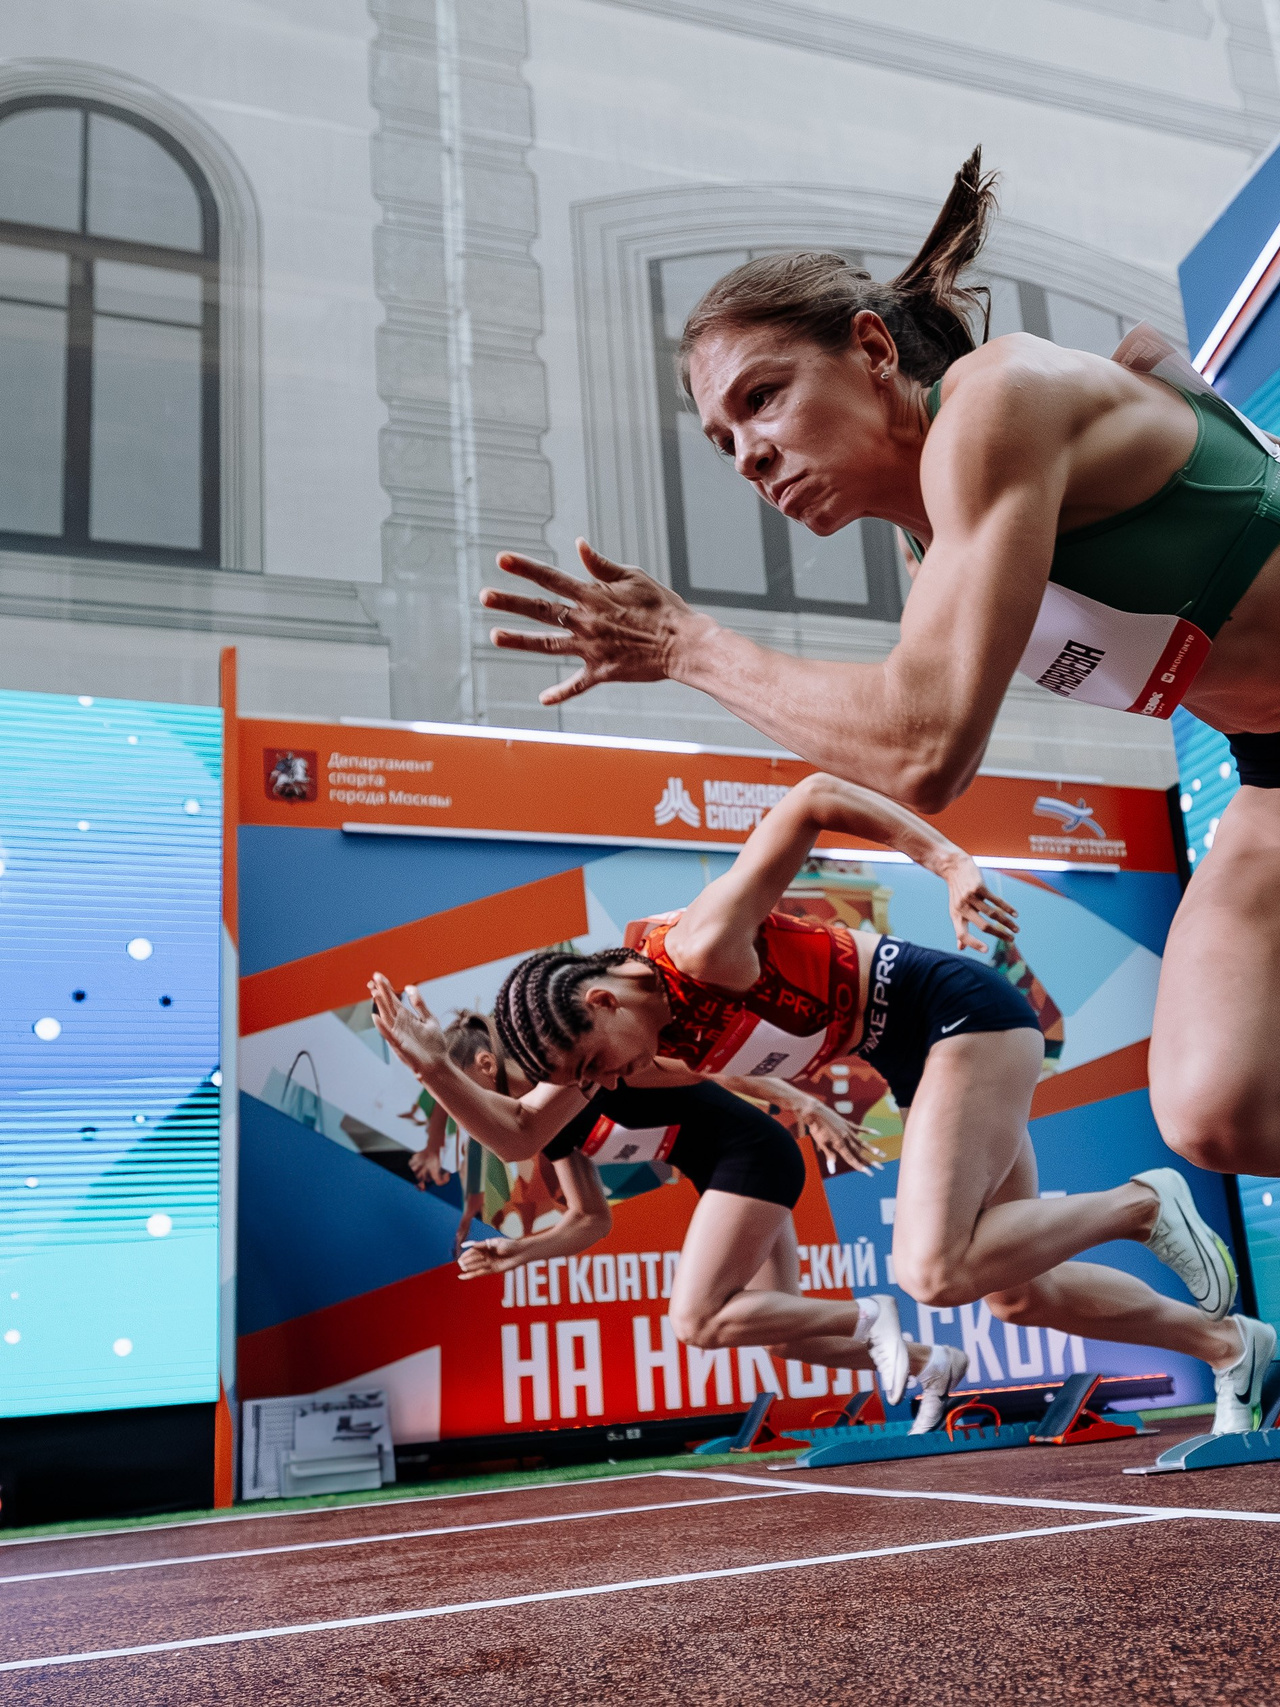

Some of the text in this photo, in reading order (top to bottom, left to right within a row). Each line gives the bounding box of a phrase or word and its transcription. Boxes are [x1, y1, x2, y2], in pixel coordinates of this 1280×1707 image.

[327, 752, 434, 772] Департамент
[328, 772, 386, 788] спорта
[329, 788, 453, 808] города Москвы
[703, 780, 794, 808] МОСКОВ
[873, 944, 900, 1006] PRO
[501, 1318, 605, 1423] НА
